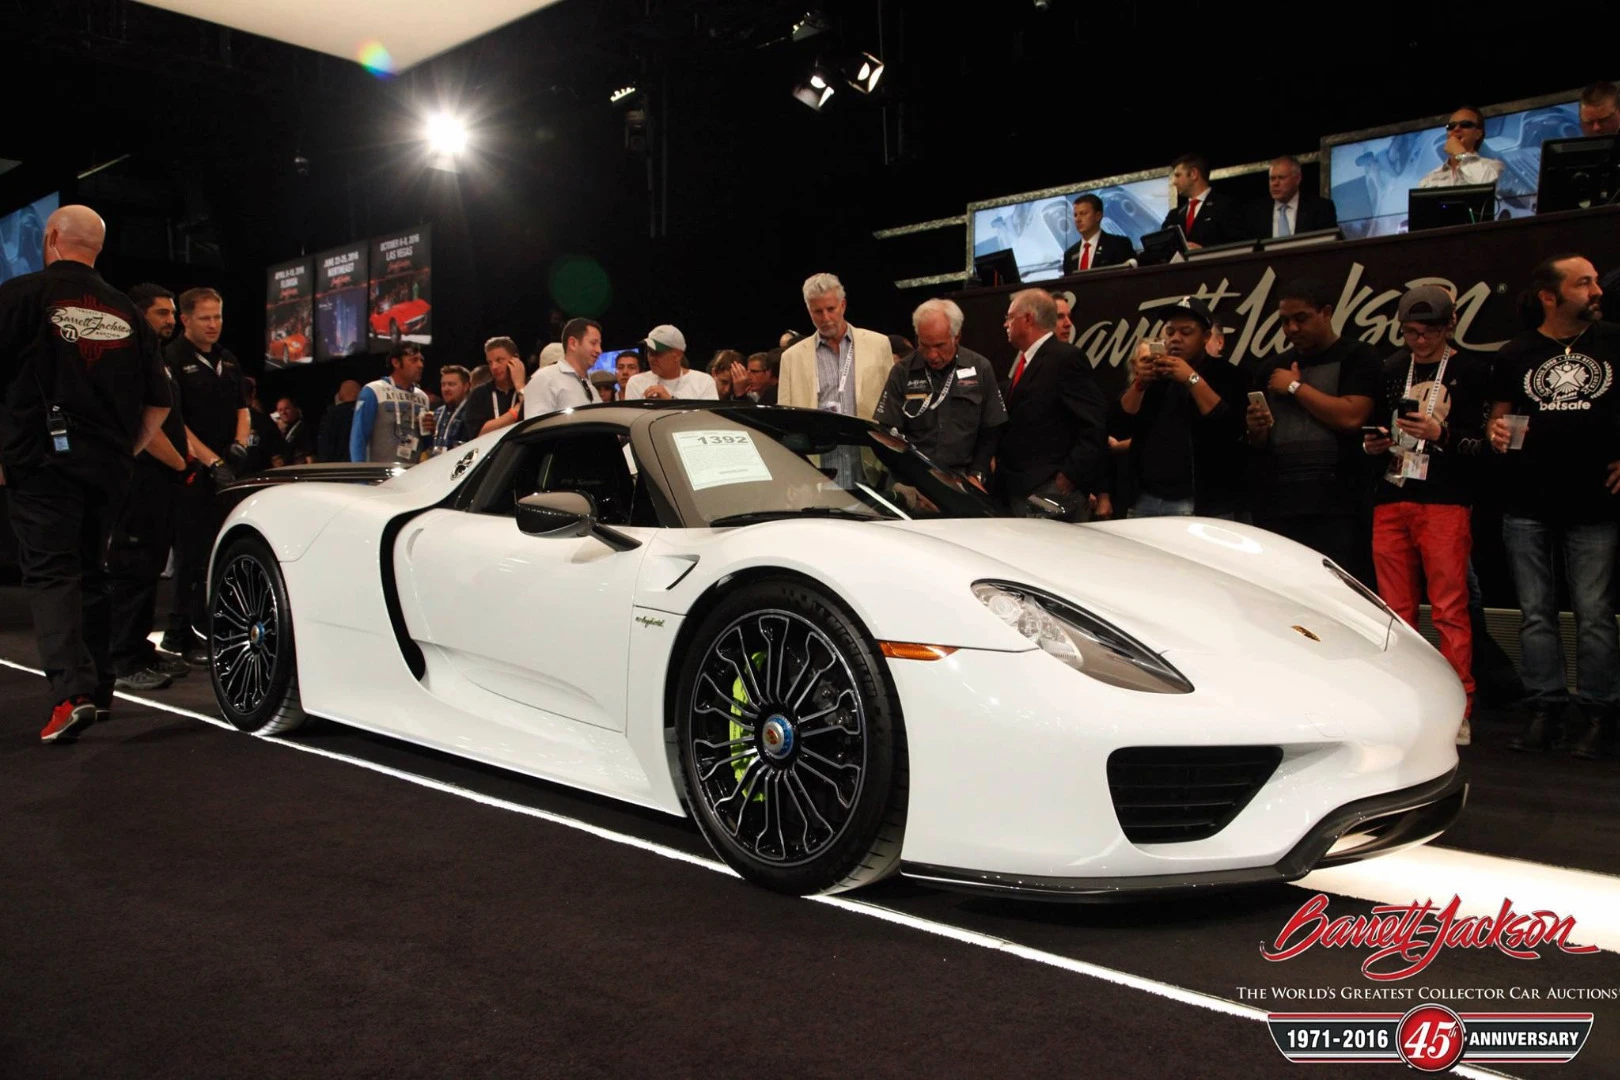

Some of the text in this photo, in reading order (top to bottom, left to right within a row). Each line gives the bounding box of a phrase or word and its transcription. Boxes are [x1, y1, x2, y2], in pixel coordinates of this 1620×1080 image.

[386, 246, 413, 261] LAS VEGAS
[63, 327, 77, 340] 71
[1539, 400, 1591, 411] betsafe
[697, 435, 748, 445] 1392
